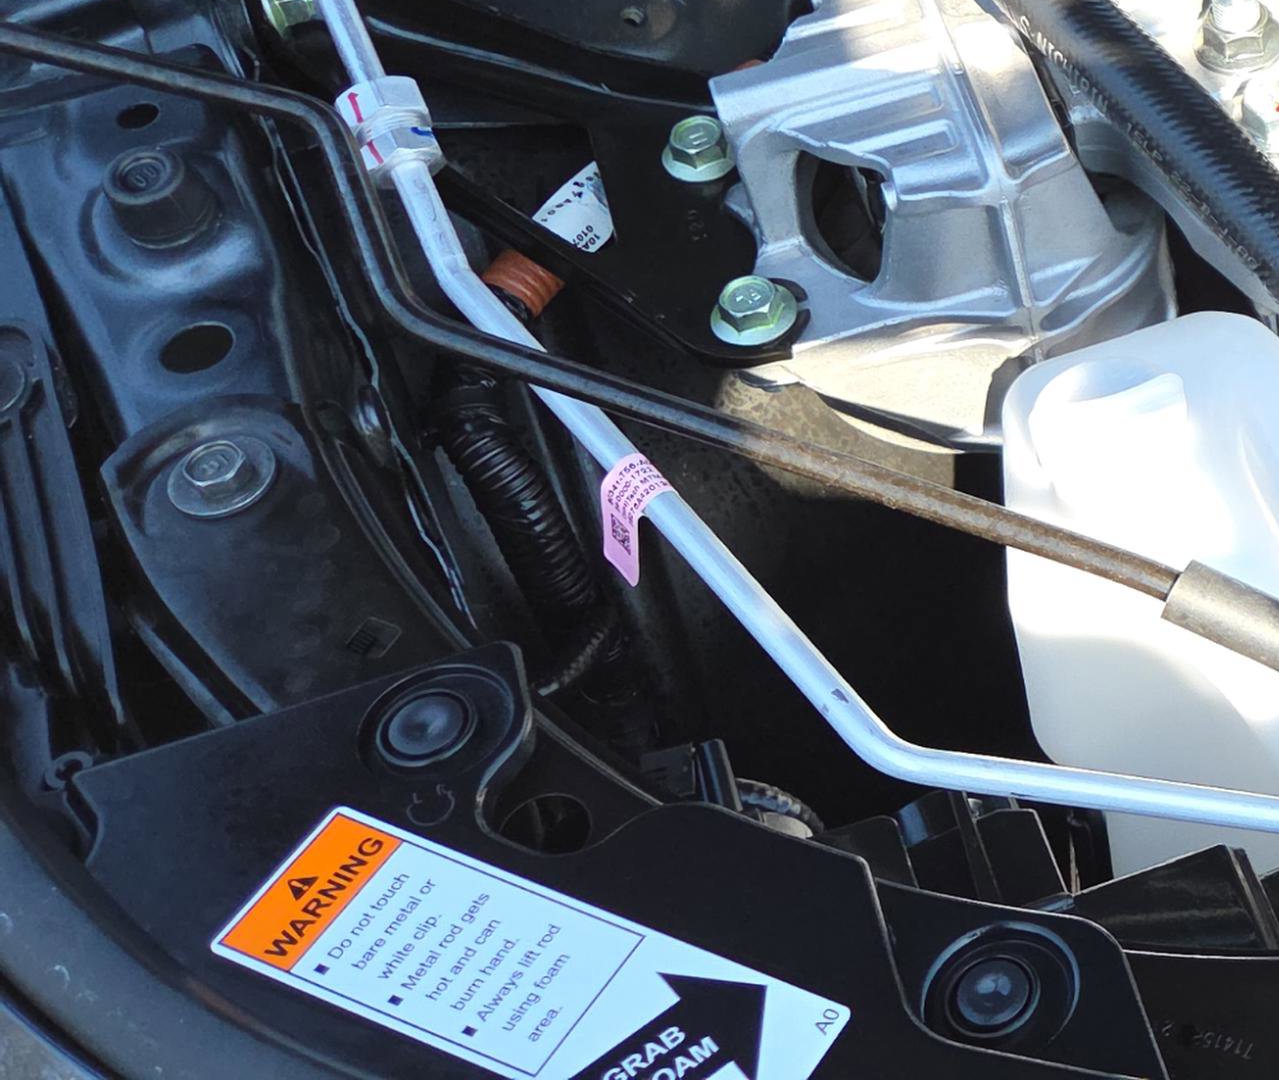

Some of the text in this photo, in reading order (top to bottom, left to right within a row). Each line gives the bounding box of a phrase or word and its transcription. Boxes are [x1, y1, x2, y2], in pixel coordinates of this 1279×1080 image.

[264, 837, 385, 959] WARNING
[327, 871, 410, 961] Do not touch
[351, 878, 437, 971] bare metal or
[377, 913, 443, 980] white clip.
[399, 891, 491, 991] Metal rod gets
[425, 918, 502, 1002] hot and can
[449, 937, 520, 1012] burn hand.
[476, 923, 561, 1023] Always lift rod
[501, 953, 571, 1032] using foam
[527, 1005, 563, 1043] area.
[814, 1008, 840, 1036] A0
[602, 1025, 686, 1080] GRAB
[651, 1035, 720, 1080] OAM
